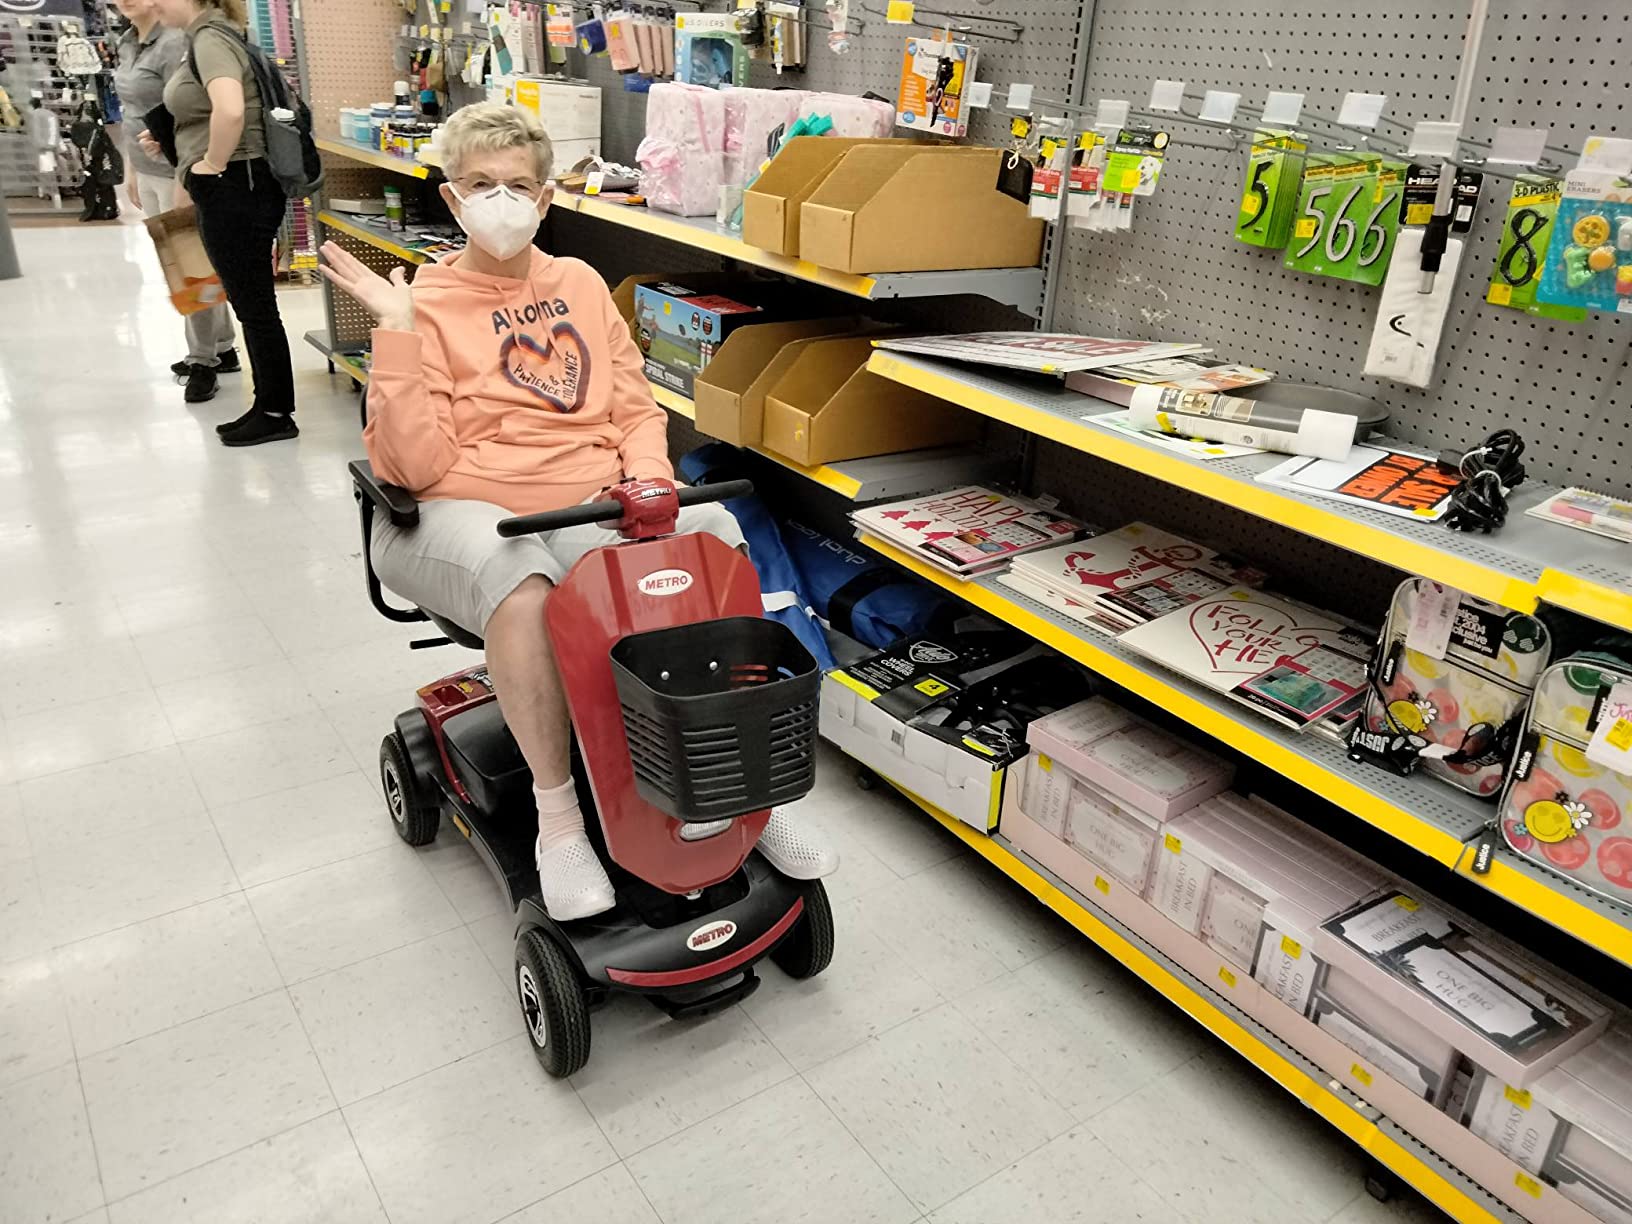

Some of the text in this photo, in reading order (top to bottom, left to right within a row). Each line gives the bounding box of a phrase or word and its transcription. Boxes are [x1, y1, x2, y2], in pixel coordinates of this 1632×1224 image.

[1240, 160, 1273, 230] 5
[1458, 185, 1477, 194] AD
[1530, 181, 1560, 196] PLASTIC
[1500, 207, 1550, 288] 8
[514, 351, 578, 401] PATIENCE & TOLERANCE
[641, 487, 672, 499] METRO
[1338, 465, 1409, 499] OWNER
[645, 575, 688, 591] METRO
[1207, 604, 1320, 646] FOLLO
[1212, 620, 1287, 652] YOUR
[1452, 626, 1488, 645] clusive
[1461, 618, 1486, 635] 2004
[880, 659, 912, 677] COVERS
[889, 657, 915, 674] WHEEL
[1383, 658, 1395, 683] Justice
[1515, 750, 1533, 779] Justice
[1475, 843, 1491, 871] Justice
[1170, 861, 1189, 913] BREAKFAST
[1186, 877, 1199, 899] BED
[692, 923, 733, 948] METRO
[1371, 911, 1422, 943] BREAKFAST
[1436, 970, 1495, 1011] ONE BIG
[1436, 983, 1470, 1009] HUG
